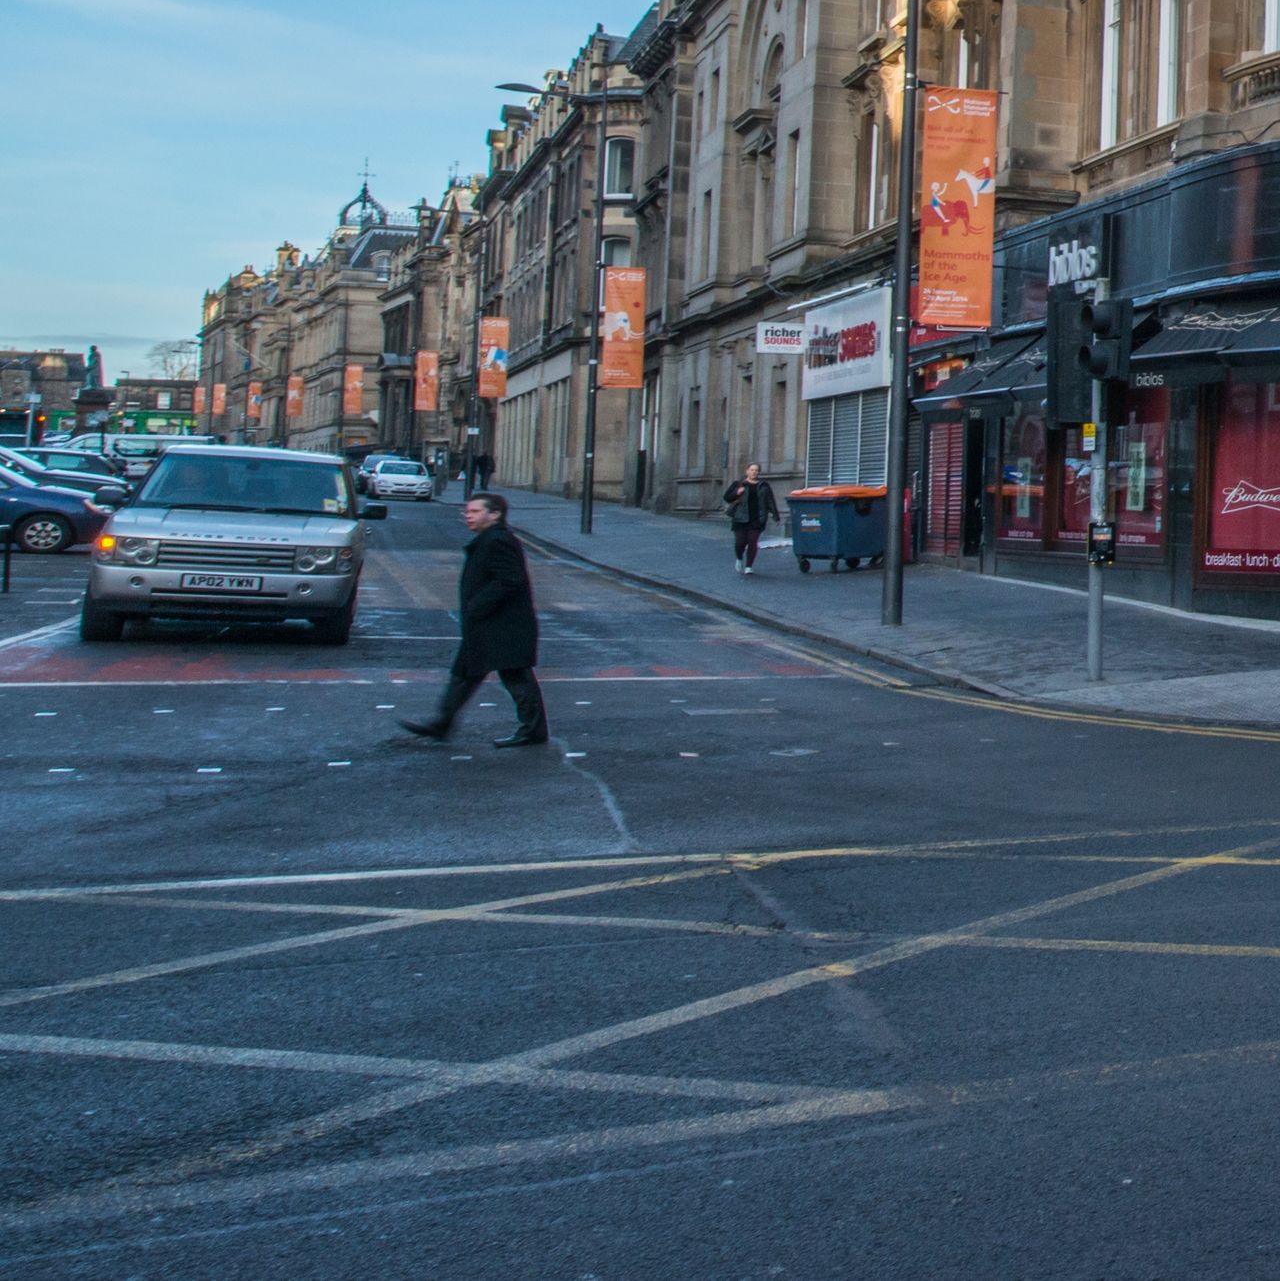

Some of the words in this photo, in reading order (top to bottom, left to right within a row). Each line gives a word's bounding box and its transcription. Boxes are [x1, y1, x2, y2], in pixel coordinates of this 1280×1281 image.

[923, 248, 991, 261] Mammoths
[923, 260, 935, 269] of
[938, 261, 957, 271] the
[1049, 239, 1097, 286] biblos
[923, 270, 940, 282] Ice
[943, 272, 968, 284] Age
[764, 326, 802, 337] richer
[764, 336, 802, 345] SOUNDS
[1136, 373, 1164, 387] biblos
[1205, 553, 1242, 566] breakfast
[1245, 552, 1269, 567] lunch
[189, 576, 224, 587] AP02
